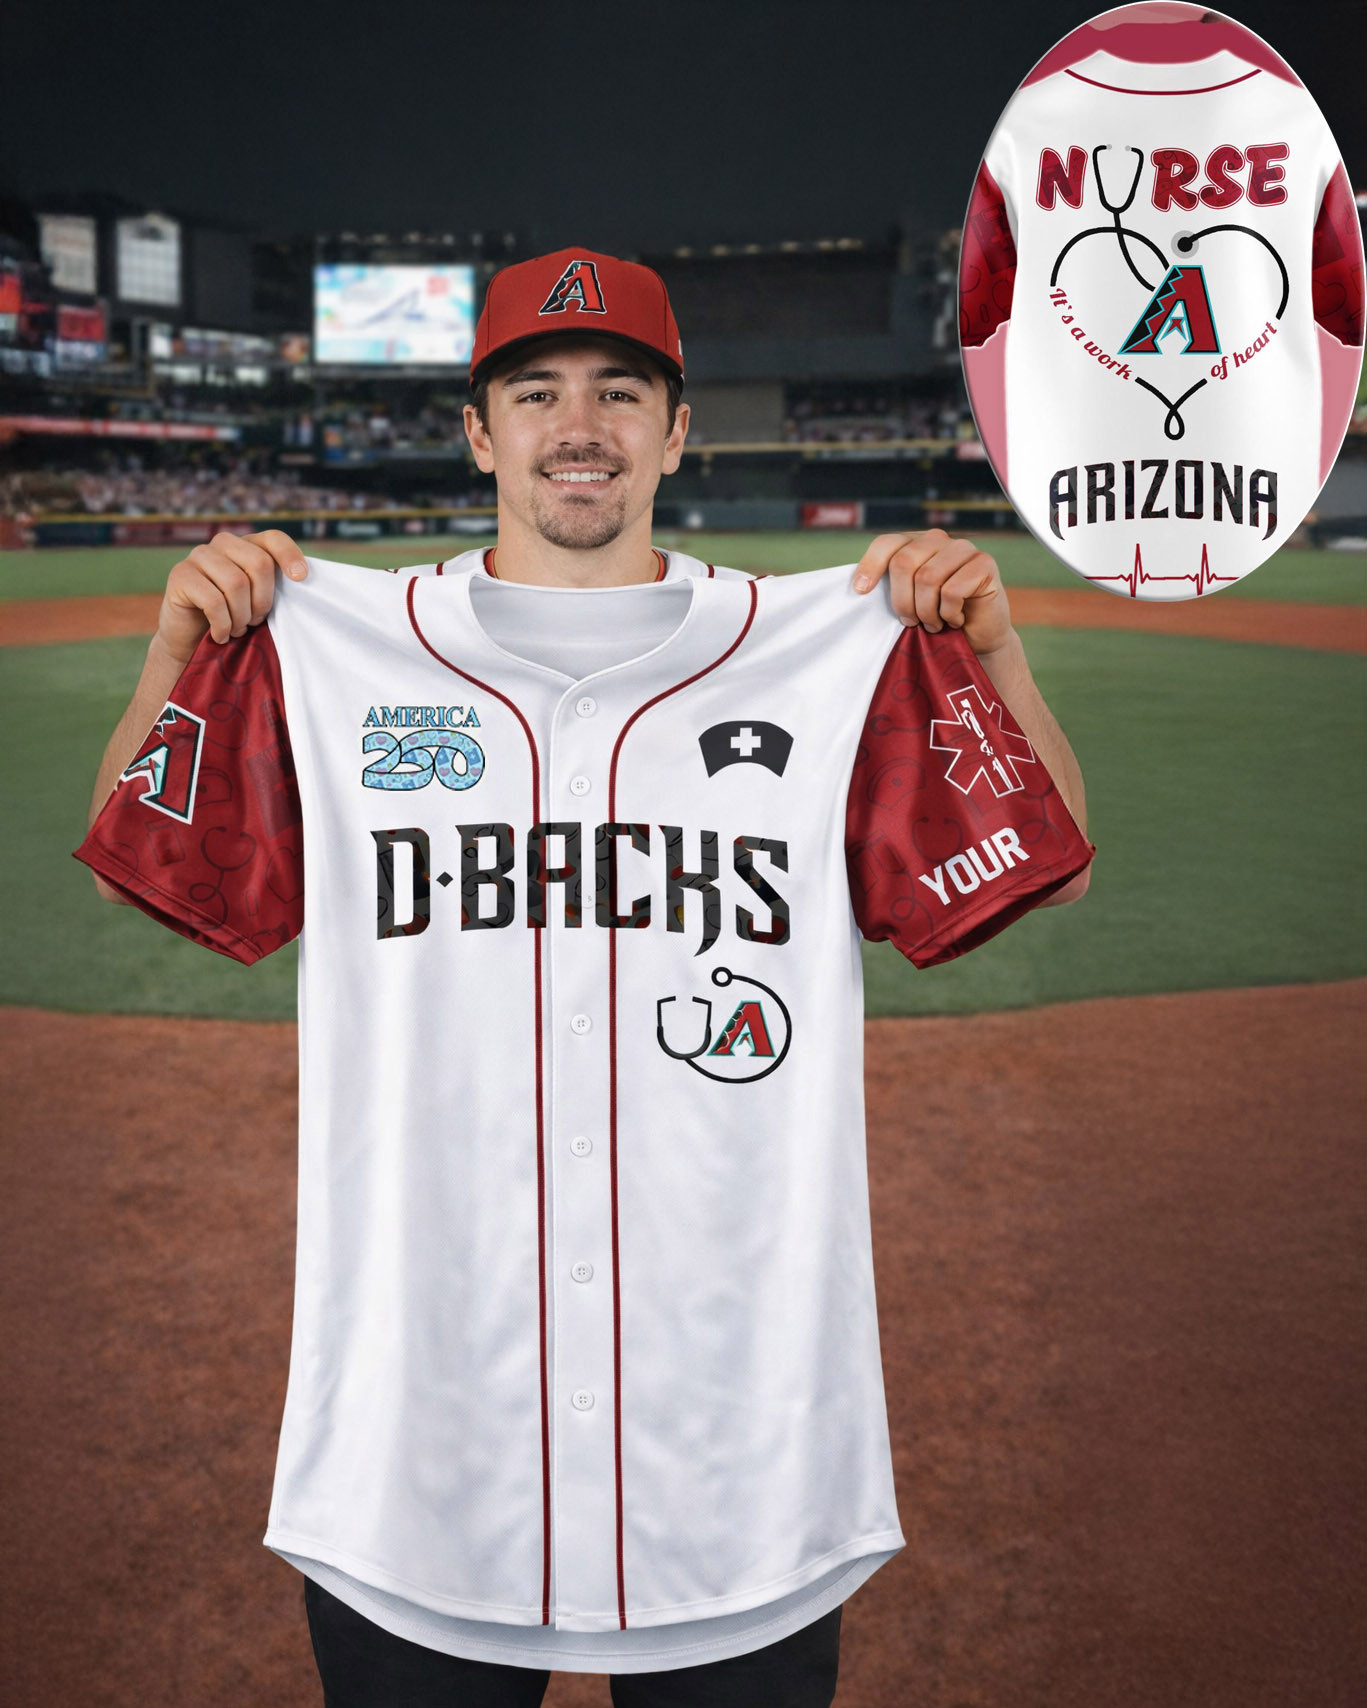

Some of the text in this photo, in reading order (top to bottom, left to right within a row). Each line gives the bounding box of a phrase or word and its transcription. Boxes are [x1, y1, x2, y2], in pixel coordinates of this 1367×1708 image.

[1035, 141, 1290, 213] NURSE
[538, 259, 608, 316] A
[1117, 264, 1223, 355] A
[1049, 288, 1277, 380] It's a work of heart
[1049, 459, 1279, 541] ARIZONA
[362, 706, 481, 728] AMERICA
[362, 728, 486, 791] 250
[918, 826, 1031, 906] YOUR
[706, 1000, 777, 1058] A
